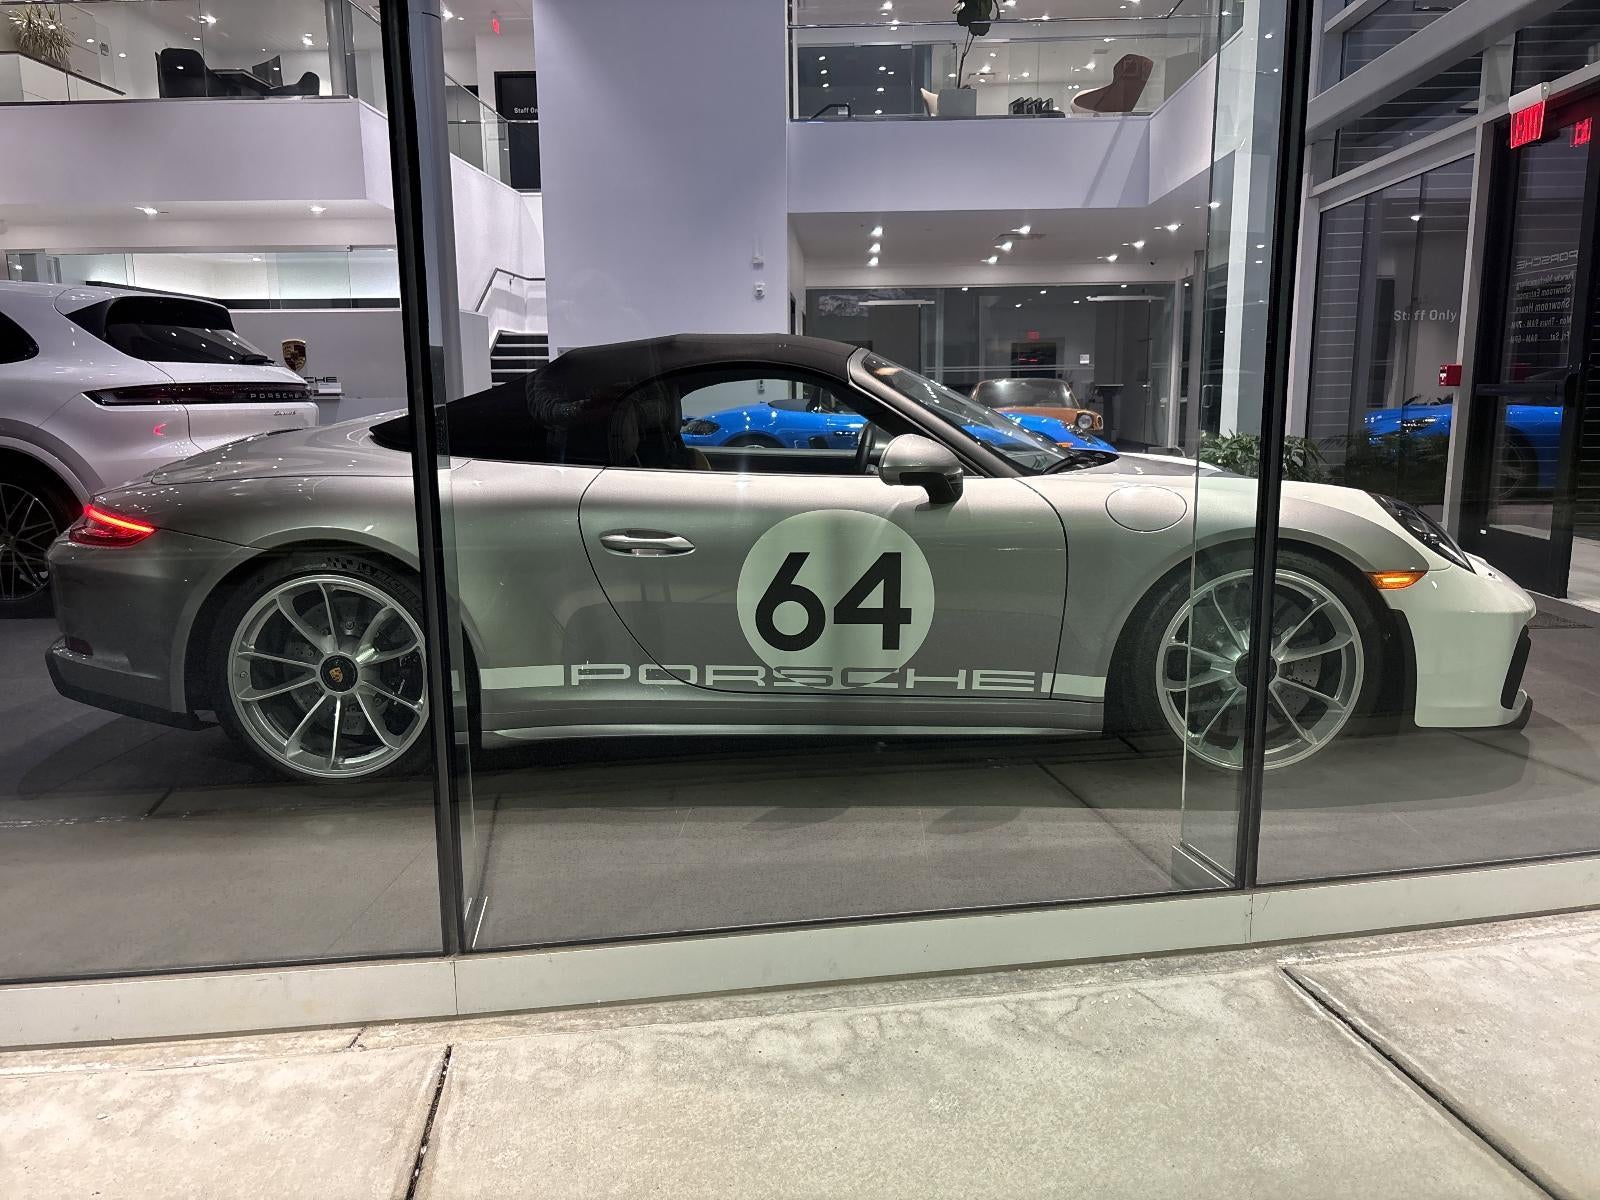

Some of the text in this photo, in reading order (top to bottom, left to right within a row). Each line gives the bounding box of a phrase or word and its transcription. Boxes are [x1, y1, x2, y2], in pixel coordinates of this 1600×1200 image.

[1429, 309, 1457, 323] Only
[755, 552, 912, 652] 64
[570, 663, 1035, 692] PORSCHE
